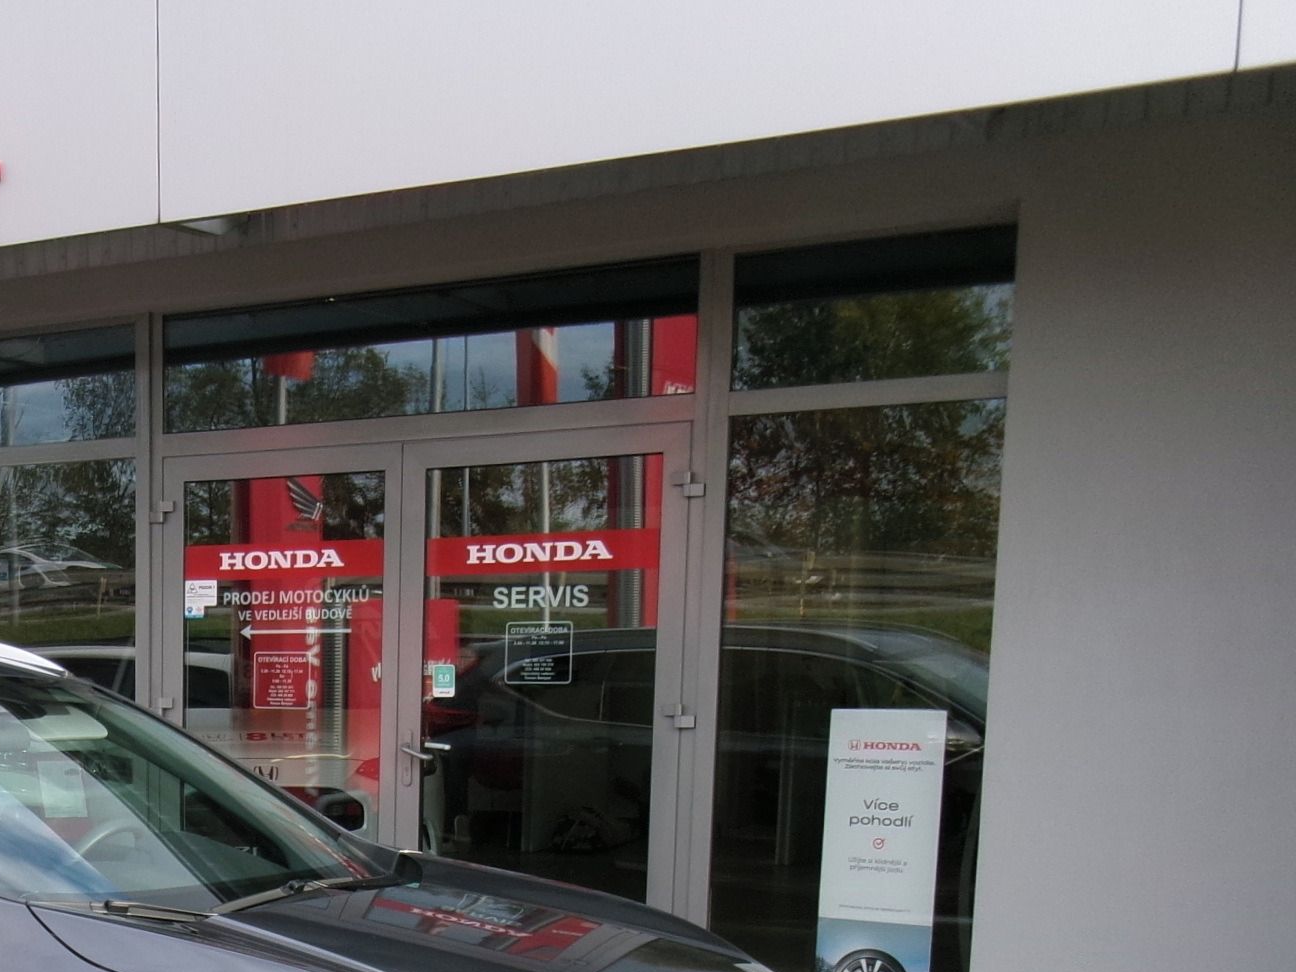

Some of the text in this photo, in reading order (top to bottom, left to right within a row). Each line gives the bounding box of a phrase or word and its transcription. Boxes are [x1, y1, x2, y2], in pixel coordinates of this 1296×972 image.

[219, 549, 344, 570] HONDA
[466, 540, 613, 564] HONDA
[223, 591, 275, 606] PRODEJ
[279, 584, 369, 604] MOTOCYKLŮ
[492, 584, 589, 609] SERVIS
[238, 606, 353, 621] VE VEDLEJŠÍ BUDOVĚ
[863, 741, 922, 751] HONDA
[863, 798, 899, 812] Více
[849, 815, 914, 828] pohodlí
